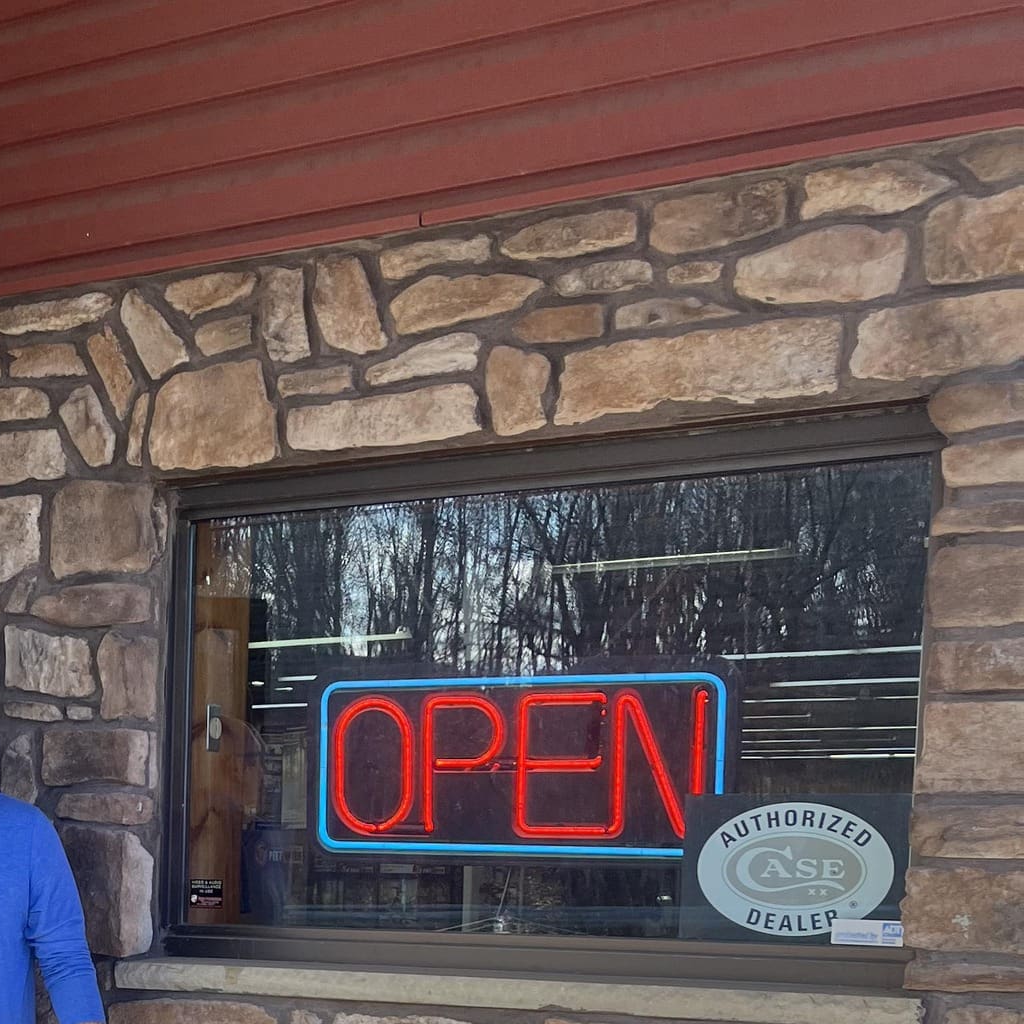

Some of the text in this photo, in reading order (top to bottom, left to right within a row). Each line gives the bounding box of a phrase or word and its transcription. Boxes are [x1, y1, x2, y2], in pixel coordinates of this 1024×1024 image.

[333, 690, 708, 839] OPEN
[720, 809, 873, 849] AUTHORIZED
[736, 845, 846, 893] CASE
[747, 907, 840, 932] DEALER
